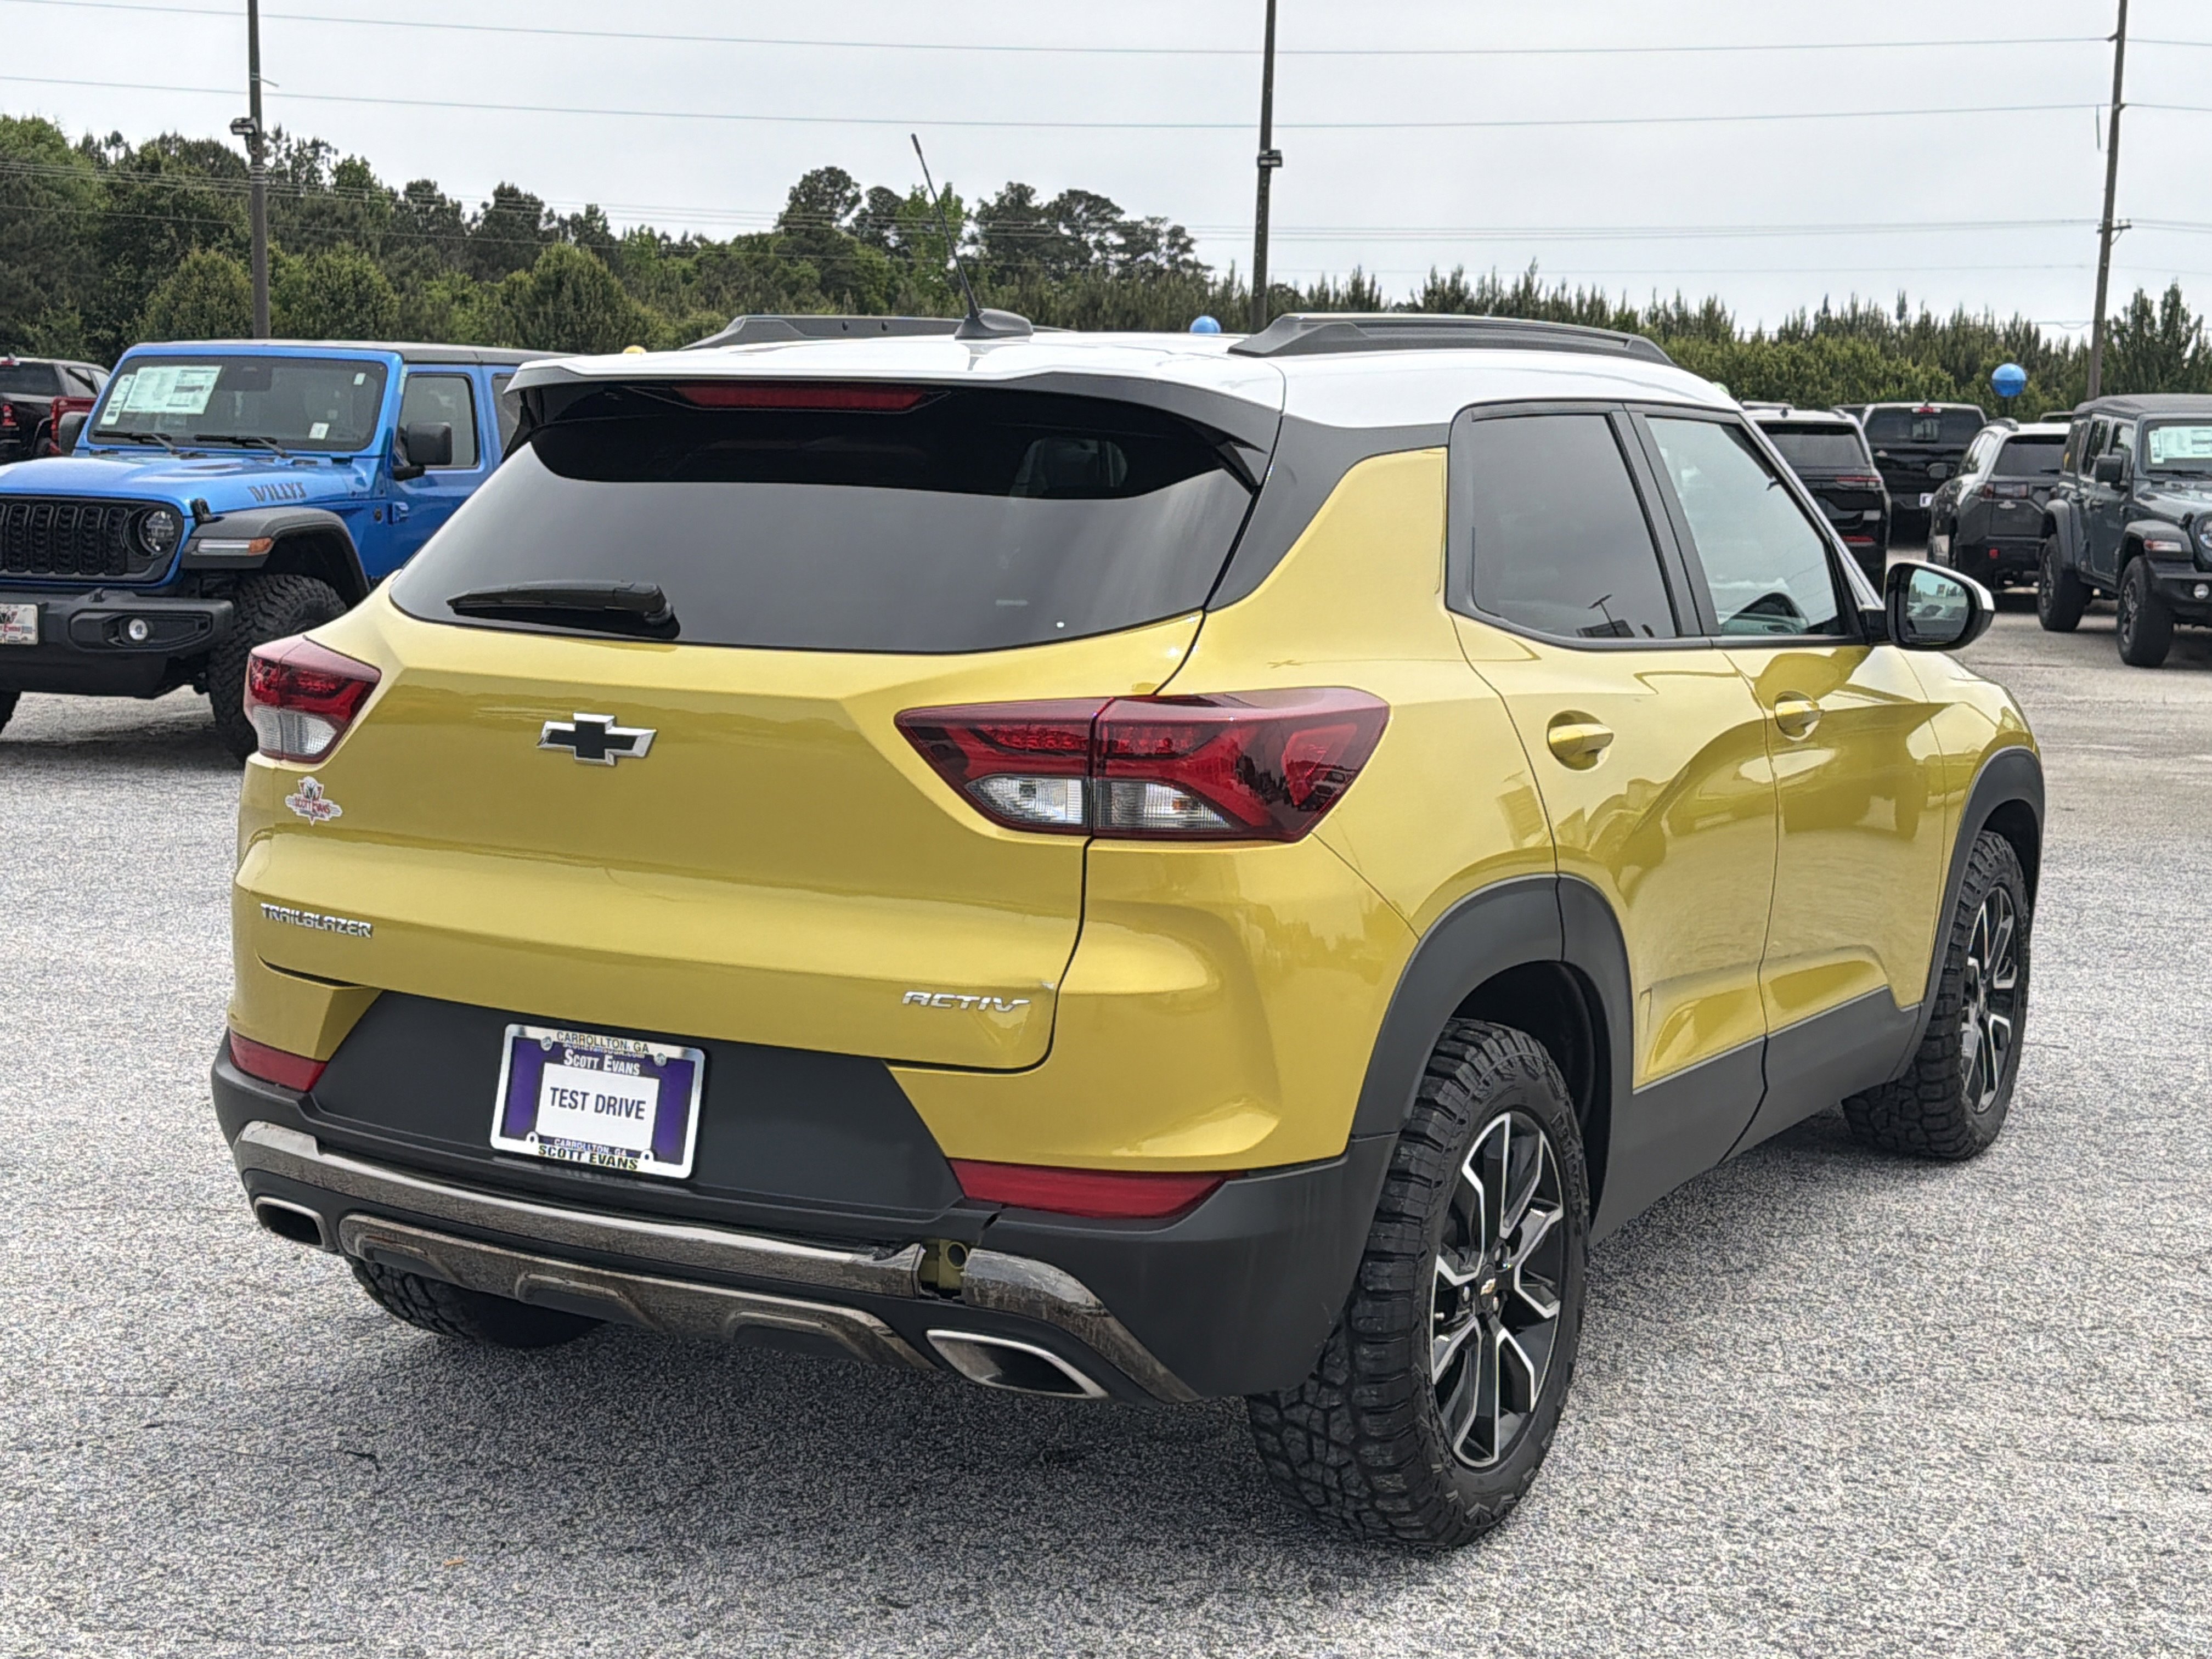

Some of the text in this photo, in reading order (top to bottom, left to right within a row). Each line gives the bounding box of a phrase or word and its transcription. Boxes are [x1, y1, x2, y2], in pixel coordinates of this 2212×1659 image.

[247, 482, 307, 502] WILLYS
[261, 902, 373, 938] TRAILBLAZER
[902, 991, 1031, 1012] ACTIV
[633, 1042, 650, 1053] GA
[564, 1048, 600, 1069] SCOTT
[603, 1054, 641, 1076] EVANS
[550, 1087, 646, 1120] TEST DRIVE
[538, 1144, 639, 1170] SCOTT EVANS
